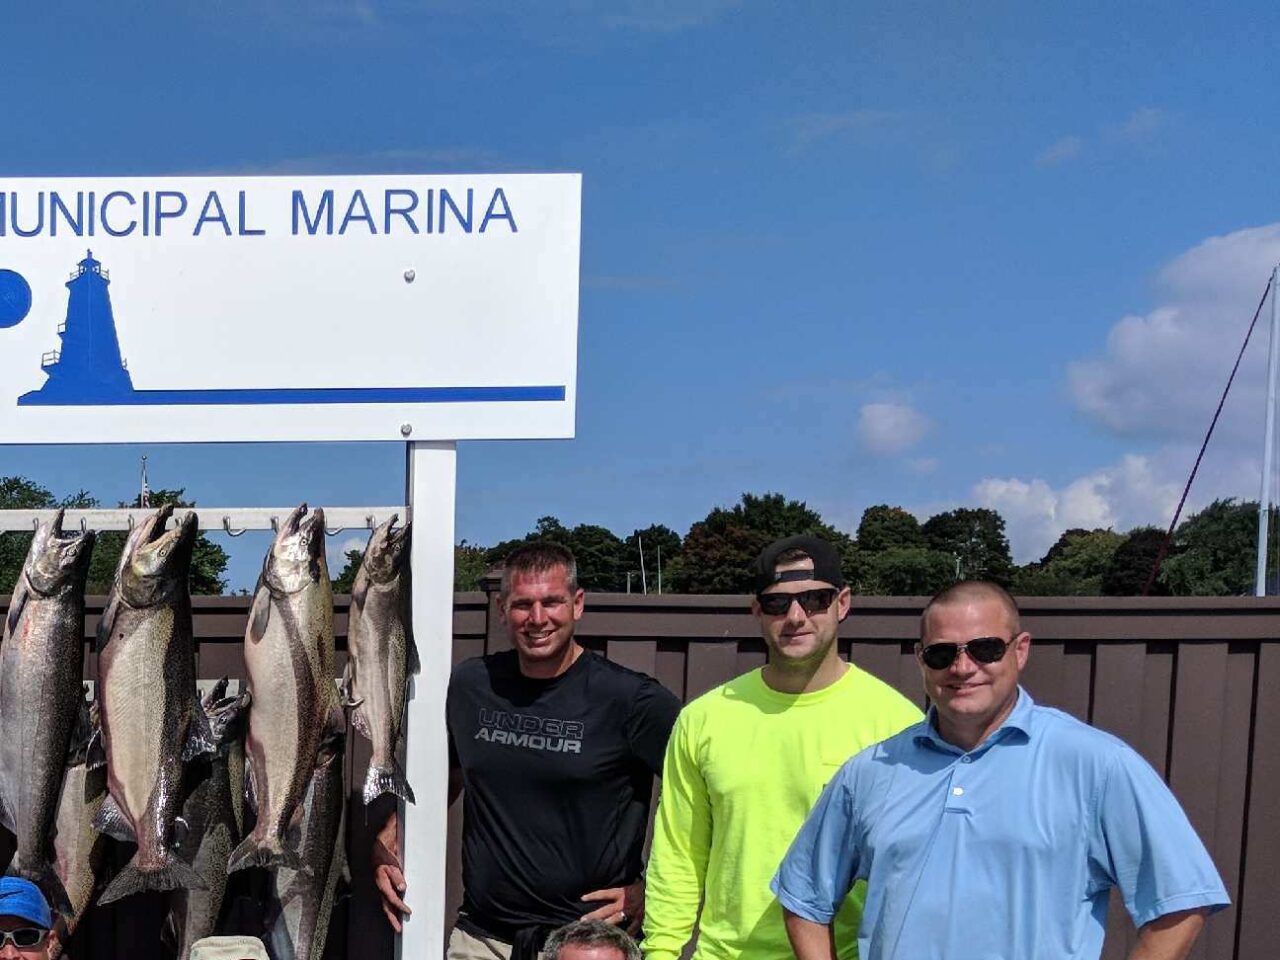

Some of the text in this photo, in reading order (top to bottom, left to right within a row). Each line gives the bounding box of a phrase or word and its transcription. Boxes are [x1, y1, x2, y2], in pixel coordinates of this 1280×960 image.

[293, 189, 516, 234] MARINA
[479, 708, 583, 739] UNDER
[475, 728, 582, 753] ARMOUR
